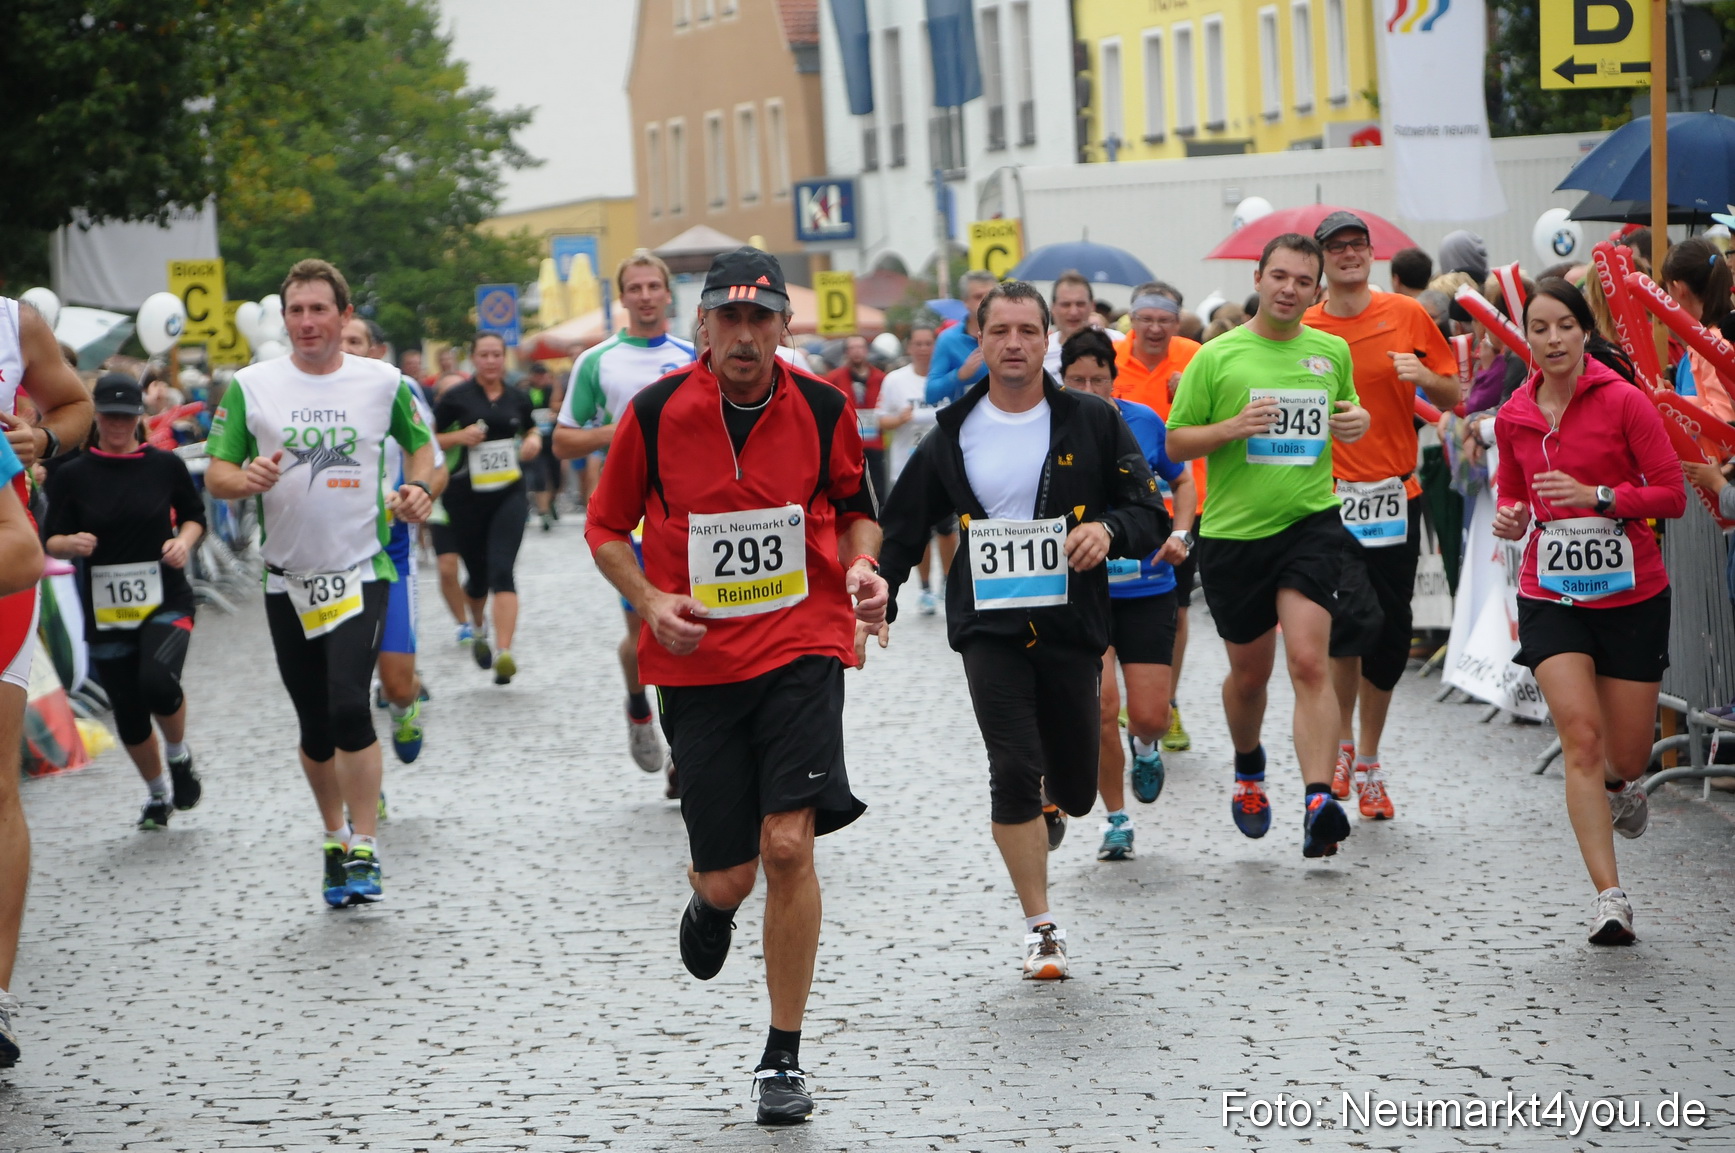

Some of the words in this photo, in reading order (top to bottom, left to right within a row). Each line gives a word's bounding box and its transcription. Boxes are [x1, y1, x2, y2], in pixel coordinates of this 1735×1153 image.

[974, 224, 1017, 239] Block
[172, 262, 216, 277] Block
[984, 245, 1008, 281] C
[183, 283, 209, 322] C
[826, 291, 848, 319] D
[291, 407, 346, 423] FÜRTH
[1260, 407, 1321, 436] 943
[282, 426, 358, 456] 2013
[1271, 442, 1306, 454] Tobias
[480, 451, 509, 470] 529
[1343, 493, 1400, 521] 2675
[690, 524, 727, 536] PARTL
[729, 519, 784, 533] Neumarkt
[971, 528, 1003, 538] PARTL
[1004, 525, 1050, 536] Neumarkt
[1569, 527, 1611, 536] Neumarkt
[712, 535, 784, 577] 293
[980, 538, 1059, 575] 3110
[1547, 539, 1624, 571] 2663
[105, 579, 147, 604] 163
[717, 580, 783, 604] Reinhold
[1562, 580, 1609, 592] Sabrina
